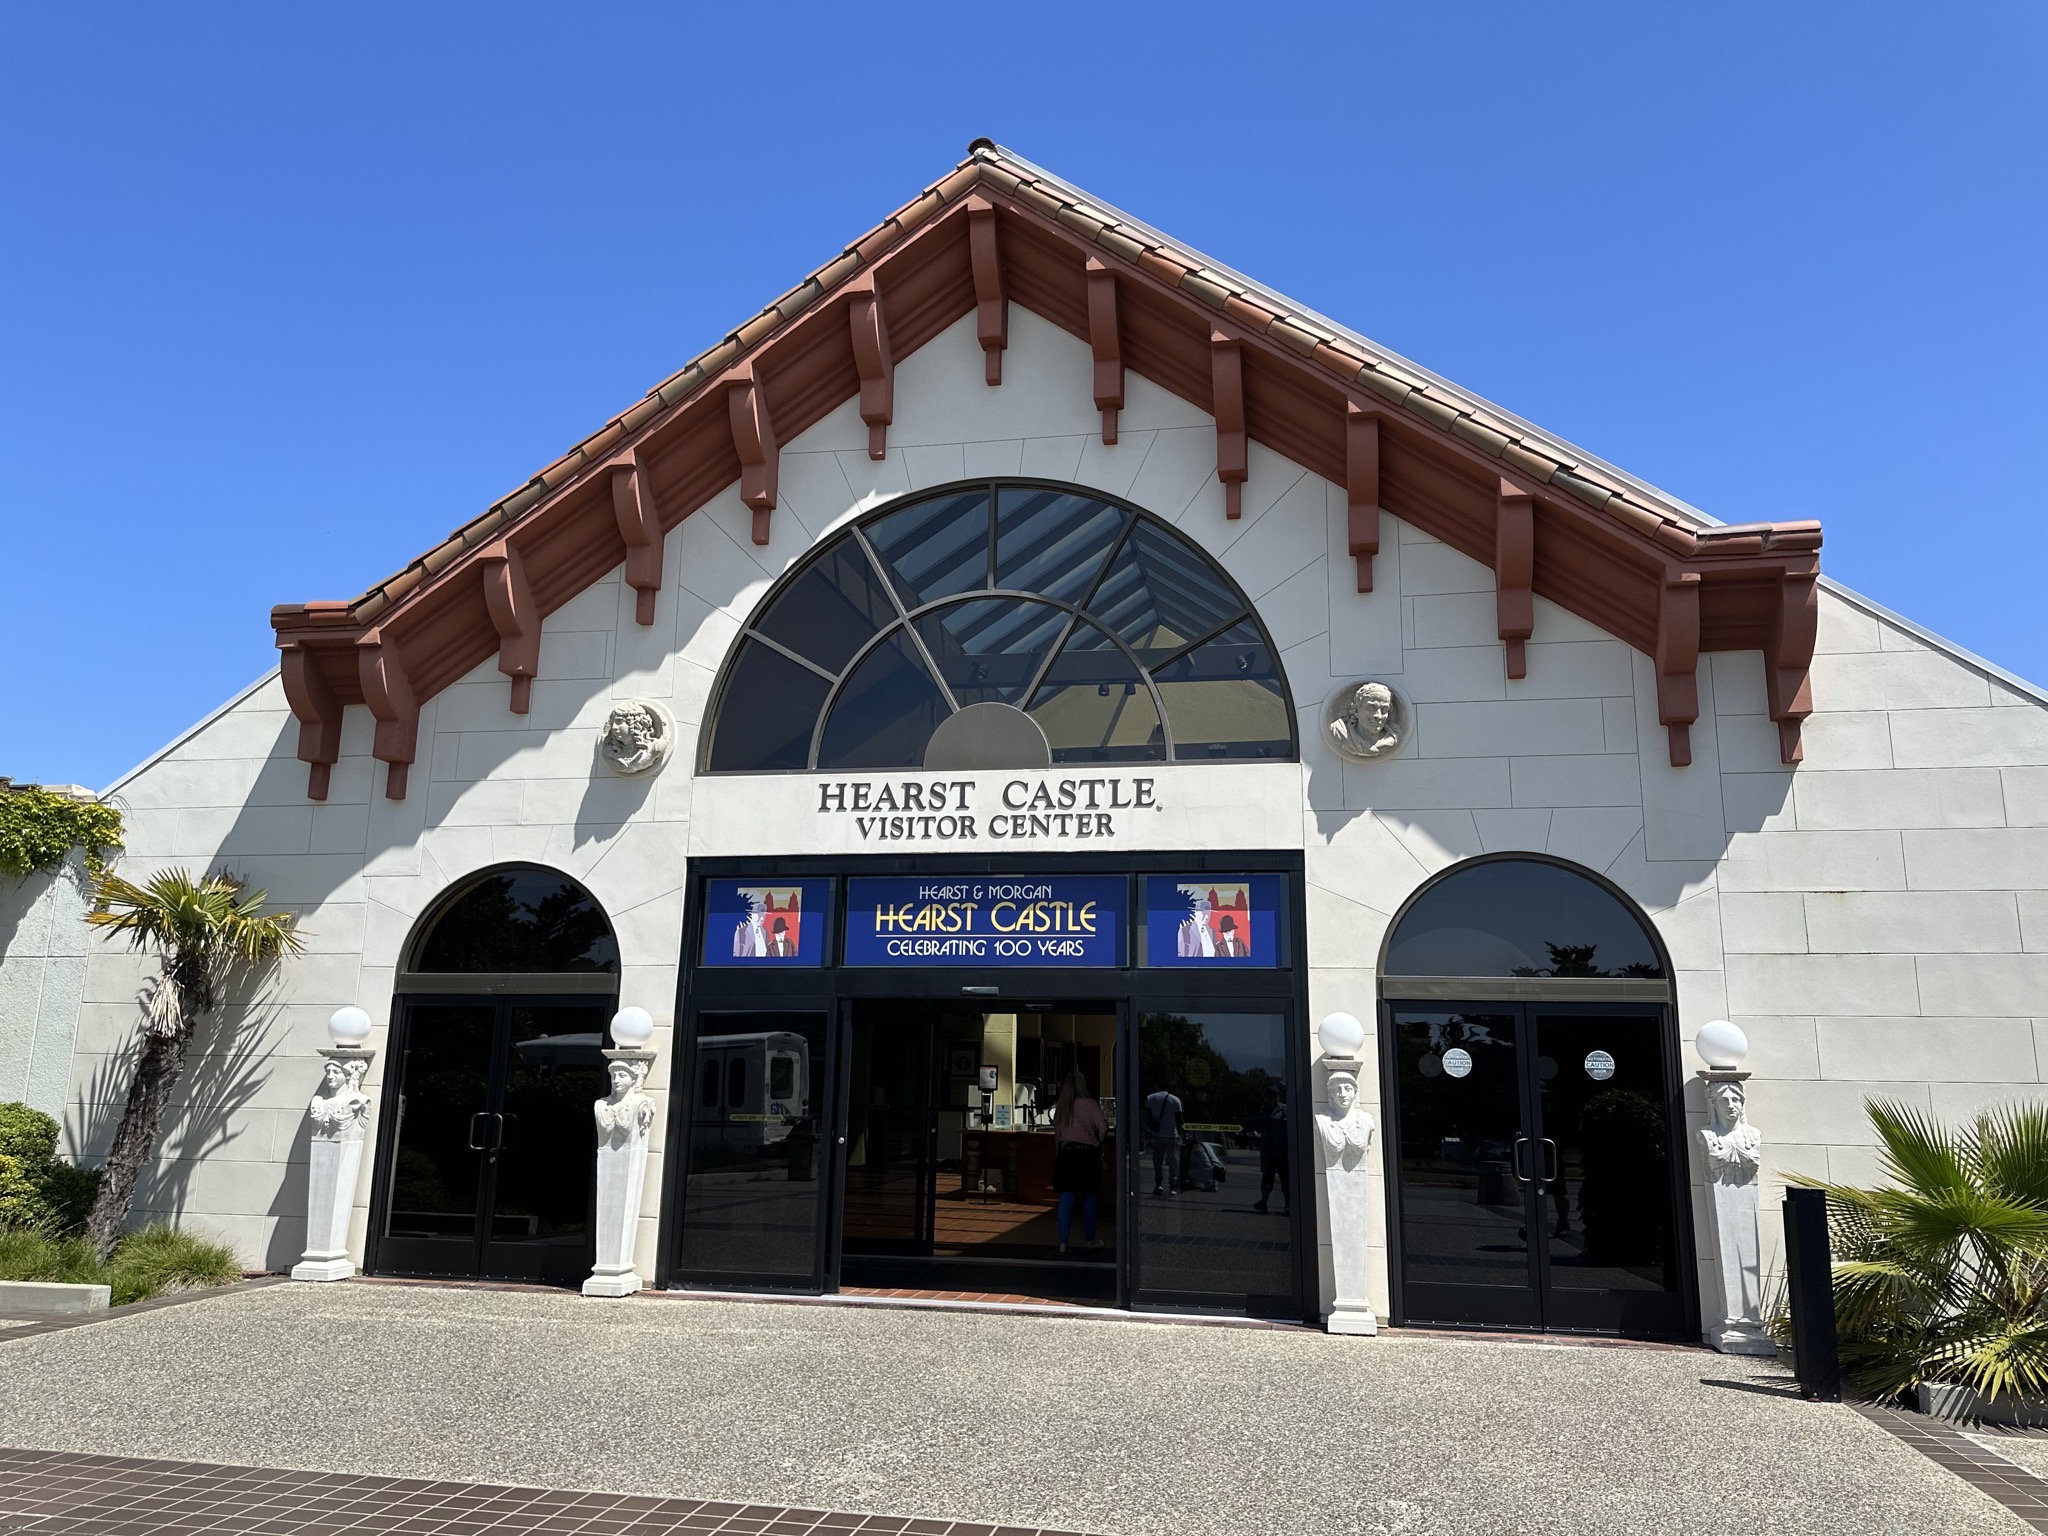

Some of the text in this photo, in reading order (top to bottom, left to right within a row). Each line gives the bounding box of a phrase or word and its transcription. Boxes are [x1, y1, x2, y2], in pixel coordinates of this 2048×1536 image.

[818, 781, 976, 812] HEARST
[856, 812, 1115, 841] VISITOR CENTER
[919, 884, 1052, 900] HEARST & MORGAN
[875, 900, 1097, 932] HEARST CASTLE
[886, 939, 1084, 956] CELEBRATING 100 YEARS
